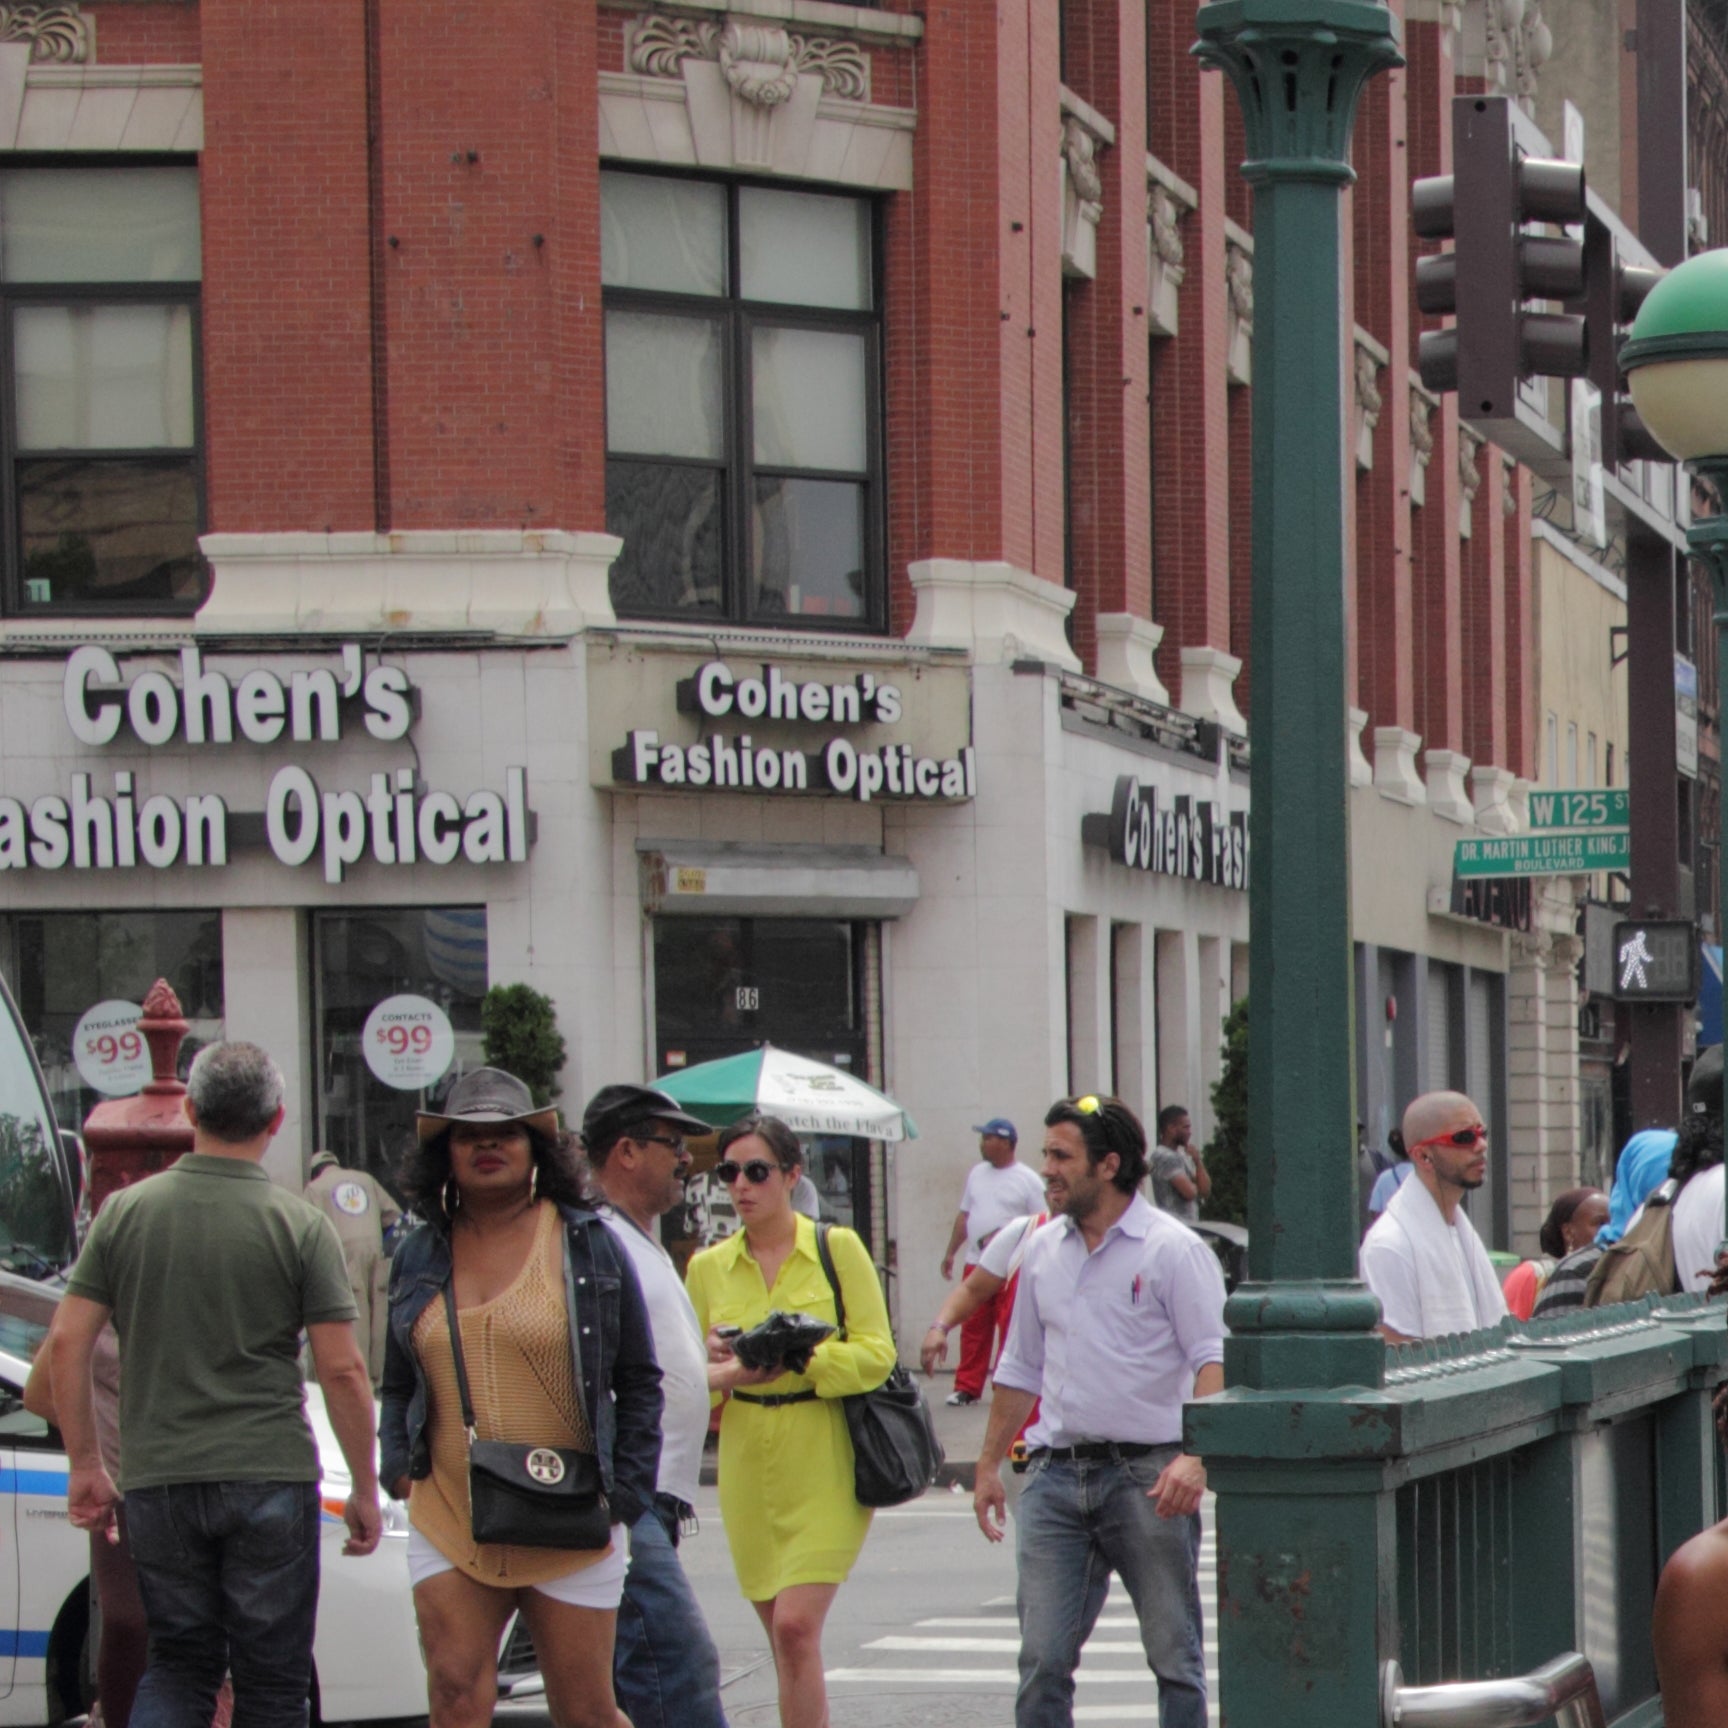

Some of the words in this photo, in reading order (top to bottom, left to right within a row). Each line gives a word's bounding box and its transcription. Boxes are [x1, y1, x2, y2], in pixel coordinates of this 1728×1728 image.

[63, 644, 411, 746] Cohen's
[699, 661, 902, 723] Cohen's
[634, 730, 806, 789] Fashion
[826, 738, 976, 800] Optical
[0, 771, 227, 869] ashion
[267, 765, 527, 883] Optical
[1532, 796, 1554, 825] W
[1562, 794, 1608, 825] 125
[1461, 844, 1480, 861] DR.
[1483, 840, 1529, 860] MARTIN
[1534, 838, 1582, 858] LUTHER
[1587, 836, 1616, 855] KING
[1514, 857, 1584, 872] BOULEVARD
[738, 988, 757, 1008] 86
[84, 1017, 142, 1032] EYEGLASSE
[381, 1013, 433, 1022] CONTACTS
[86, 1031, 142, 1064] $99
[376, 1025, 433, 1055] $99
[825, 1115, 851, 1130] the
